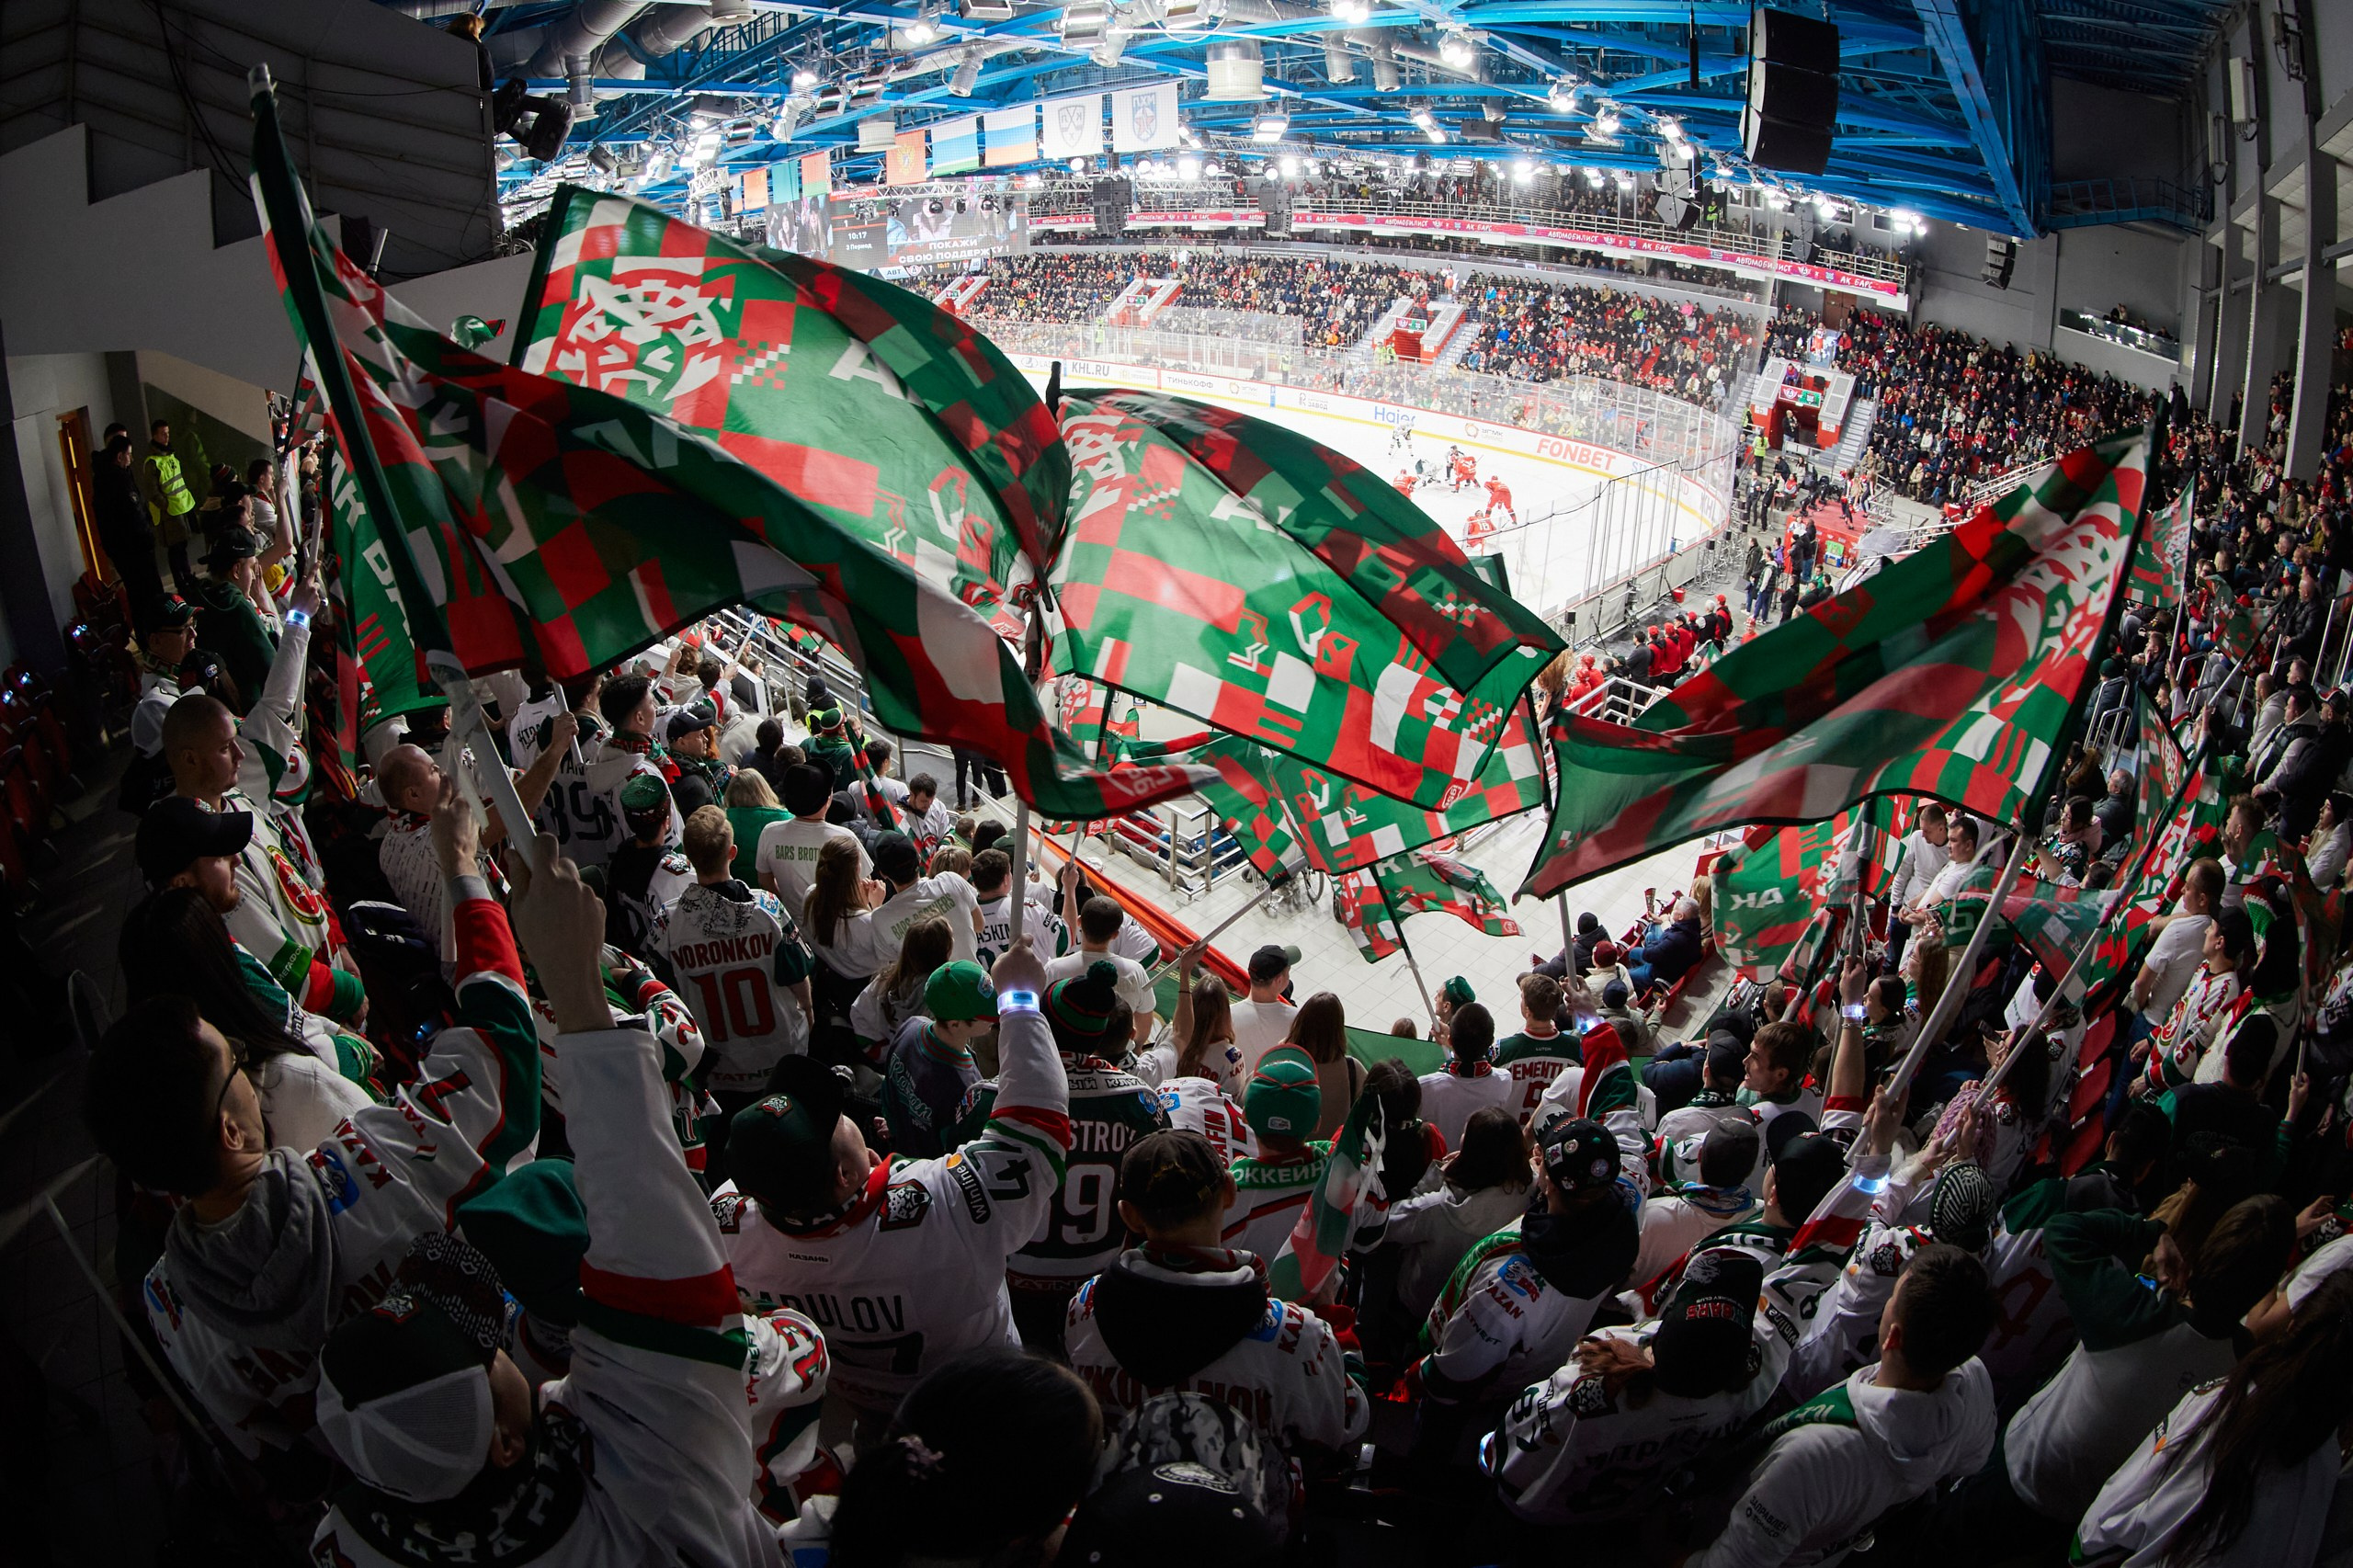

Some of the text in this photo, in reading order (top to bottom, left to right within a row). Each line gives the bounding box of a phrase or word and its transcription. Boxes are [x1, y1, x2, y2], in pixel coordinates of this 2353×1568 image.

[847, 232, 867, 240] 10:17
[928, 238, 977, 251] ПОКАЖИ
[1548, 231, 1598, 244] АВТОМОБИЛИСТ
[1642, 242, 1652, 251] АК
[1655, 243, 1673, 253] БАРС
[850, 243, 872, 251] Период
[898, 253, 933, 264] СВОЮ
[936, 245, 1004, 260] ПОДДЕРЖКУ
[1735, 256, 1792, 273] АВТОМОБИЛИСТ
[1840, 276, 1850, 285] АК
[1854, 278, 1873, 289] БАРС
[1071, 361, 1110, 377] KHL.RU
[1166, 376, 1214, 389] ТИНЬКОФФ
[1308, 401, 1328, 412] ЗАВОД
[1374, 405, 1416, 425] Haier
[1536, 437, 1617, 472] FONBET
[775, 844, 821, 862] BARS BROT
[670, 932, 774, 971] VORONKOV
[688, 967, 776, 1043] 10
[713, 1066, 775, 1083] TATNE
[956, 1165, 988, 1219] winline
[788, 1253, 829, 1263] КАЗАНЬ
[1685, 1301, 1734, 1322] BARS
[1278, 1301, 1305, 1355] KAZ
[1749, 1494, 1790, 1533] ЗАПРАВЛЕН
